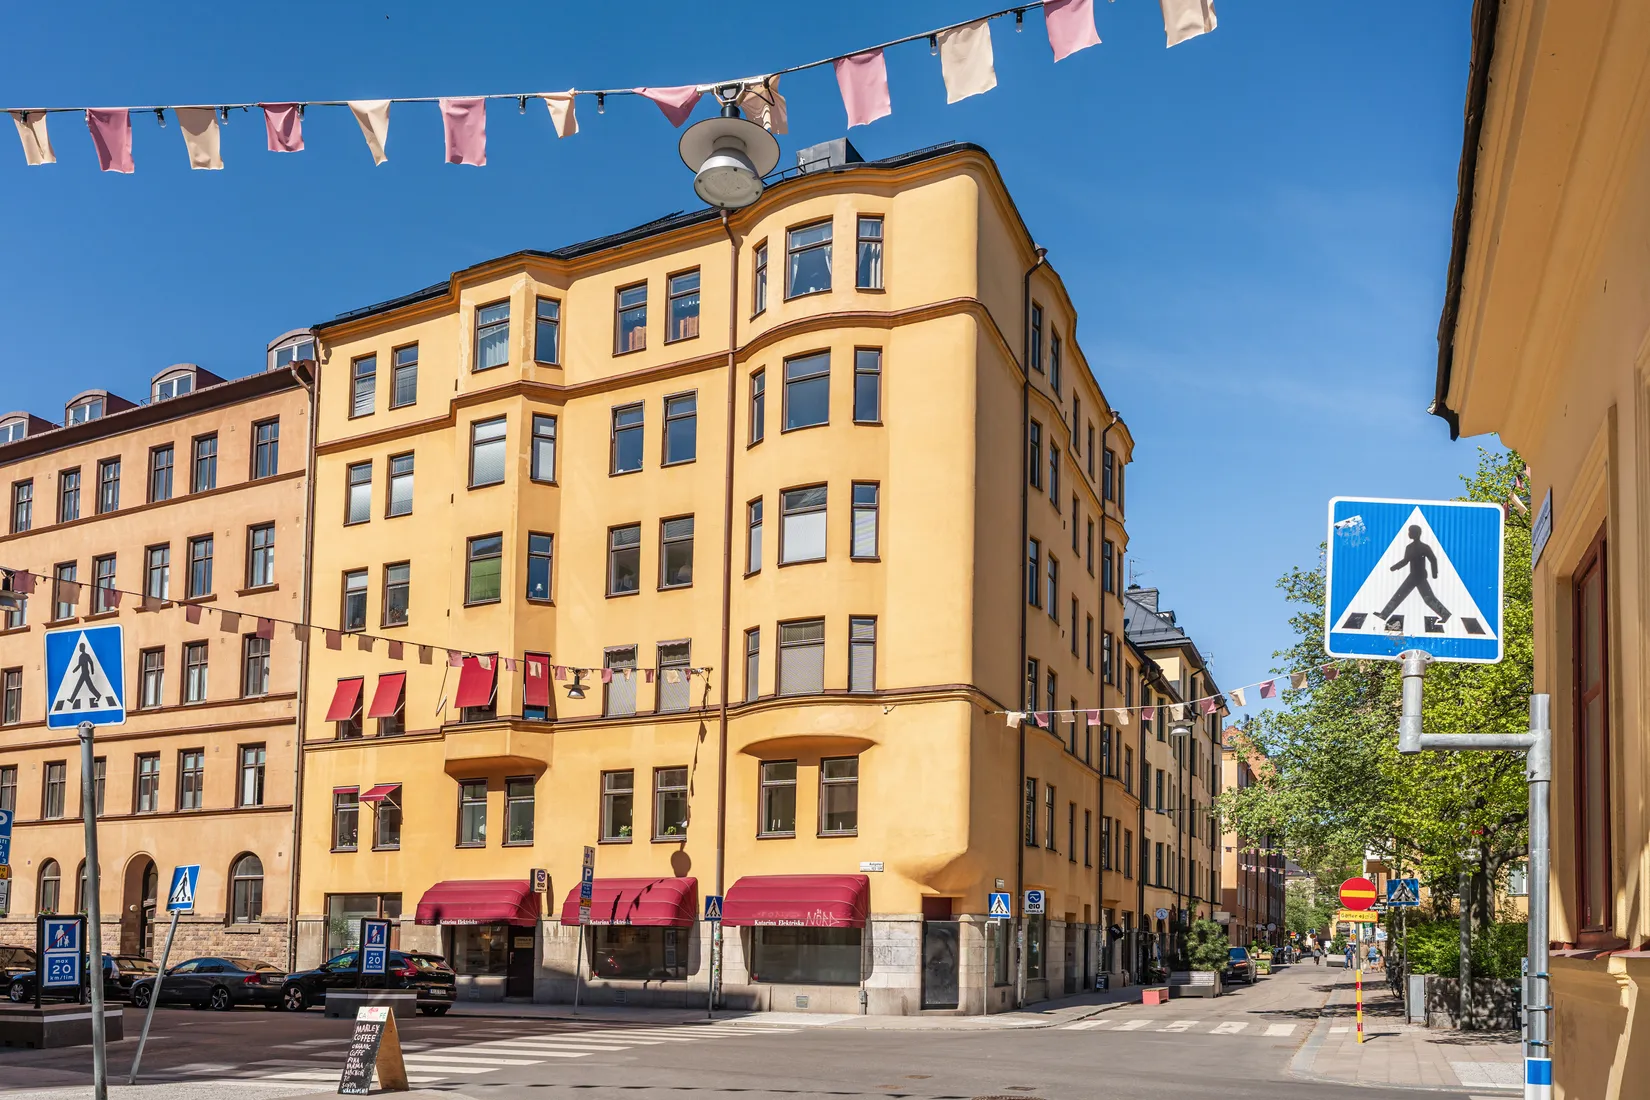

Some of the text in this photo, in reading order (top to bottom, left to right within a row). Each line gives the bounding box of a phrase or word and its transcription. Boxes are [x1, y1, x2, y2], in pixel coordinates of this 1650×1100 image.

[584, 868, 592, 881] P
[368, 956, 381, 964] 20
[52, 964, 71, 975] 20
[356, 1024, 380, 1034] MARLEY
[354, 1034, 376, 1042] COFFEE
